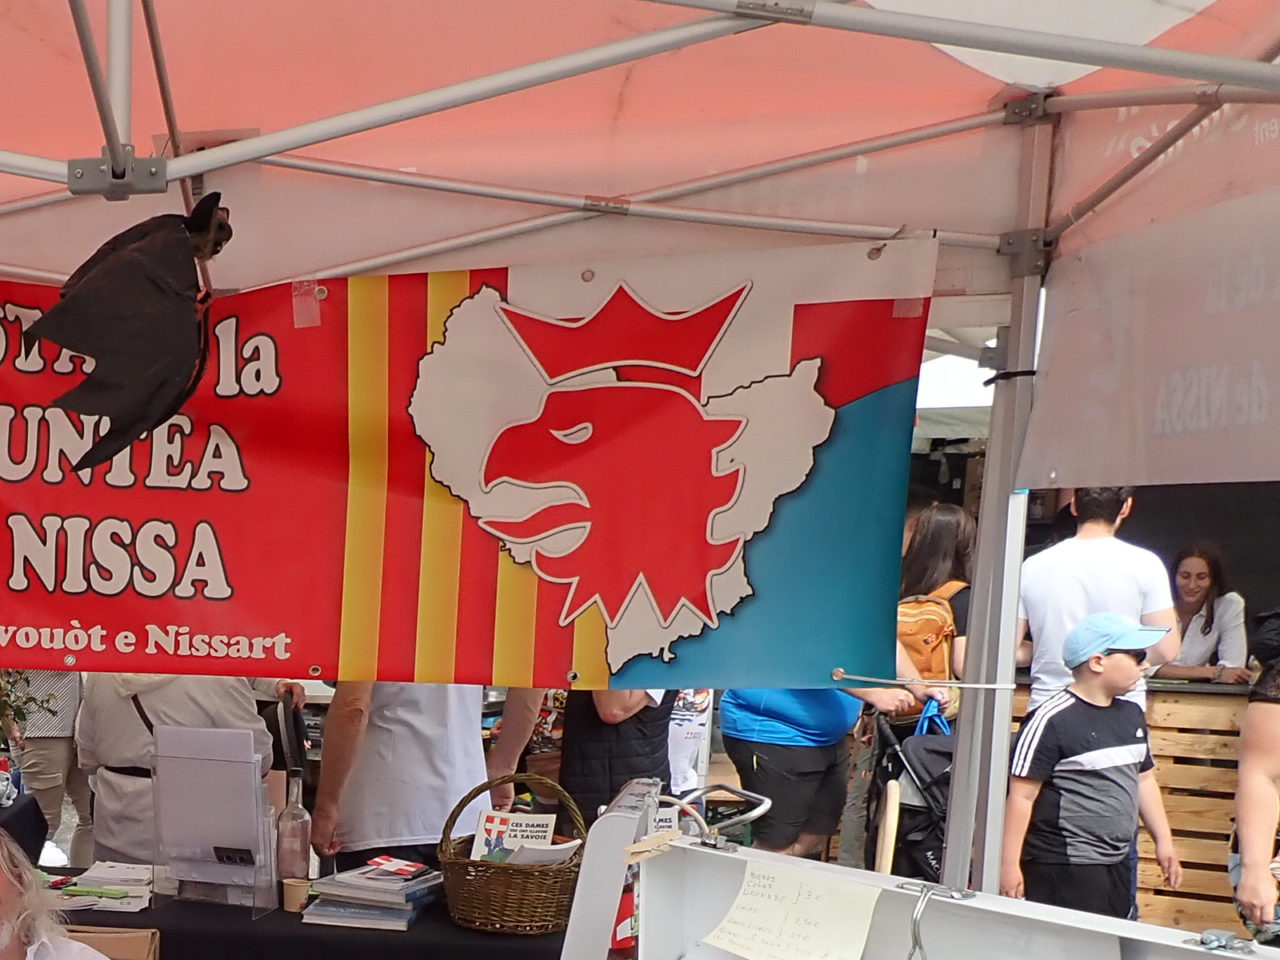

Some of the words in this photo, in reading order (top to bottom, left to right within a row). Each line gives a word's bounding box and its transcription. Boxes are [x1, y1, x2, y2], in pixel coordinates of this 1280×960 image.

[215, 316, 282, 398] la
[7, 513, 233, 600] NISSA
[114, 634, 136, 654] e
[145, 625, 291, 660] Nissart
